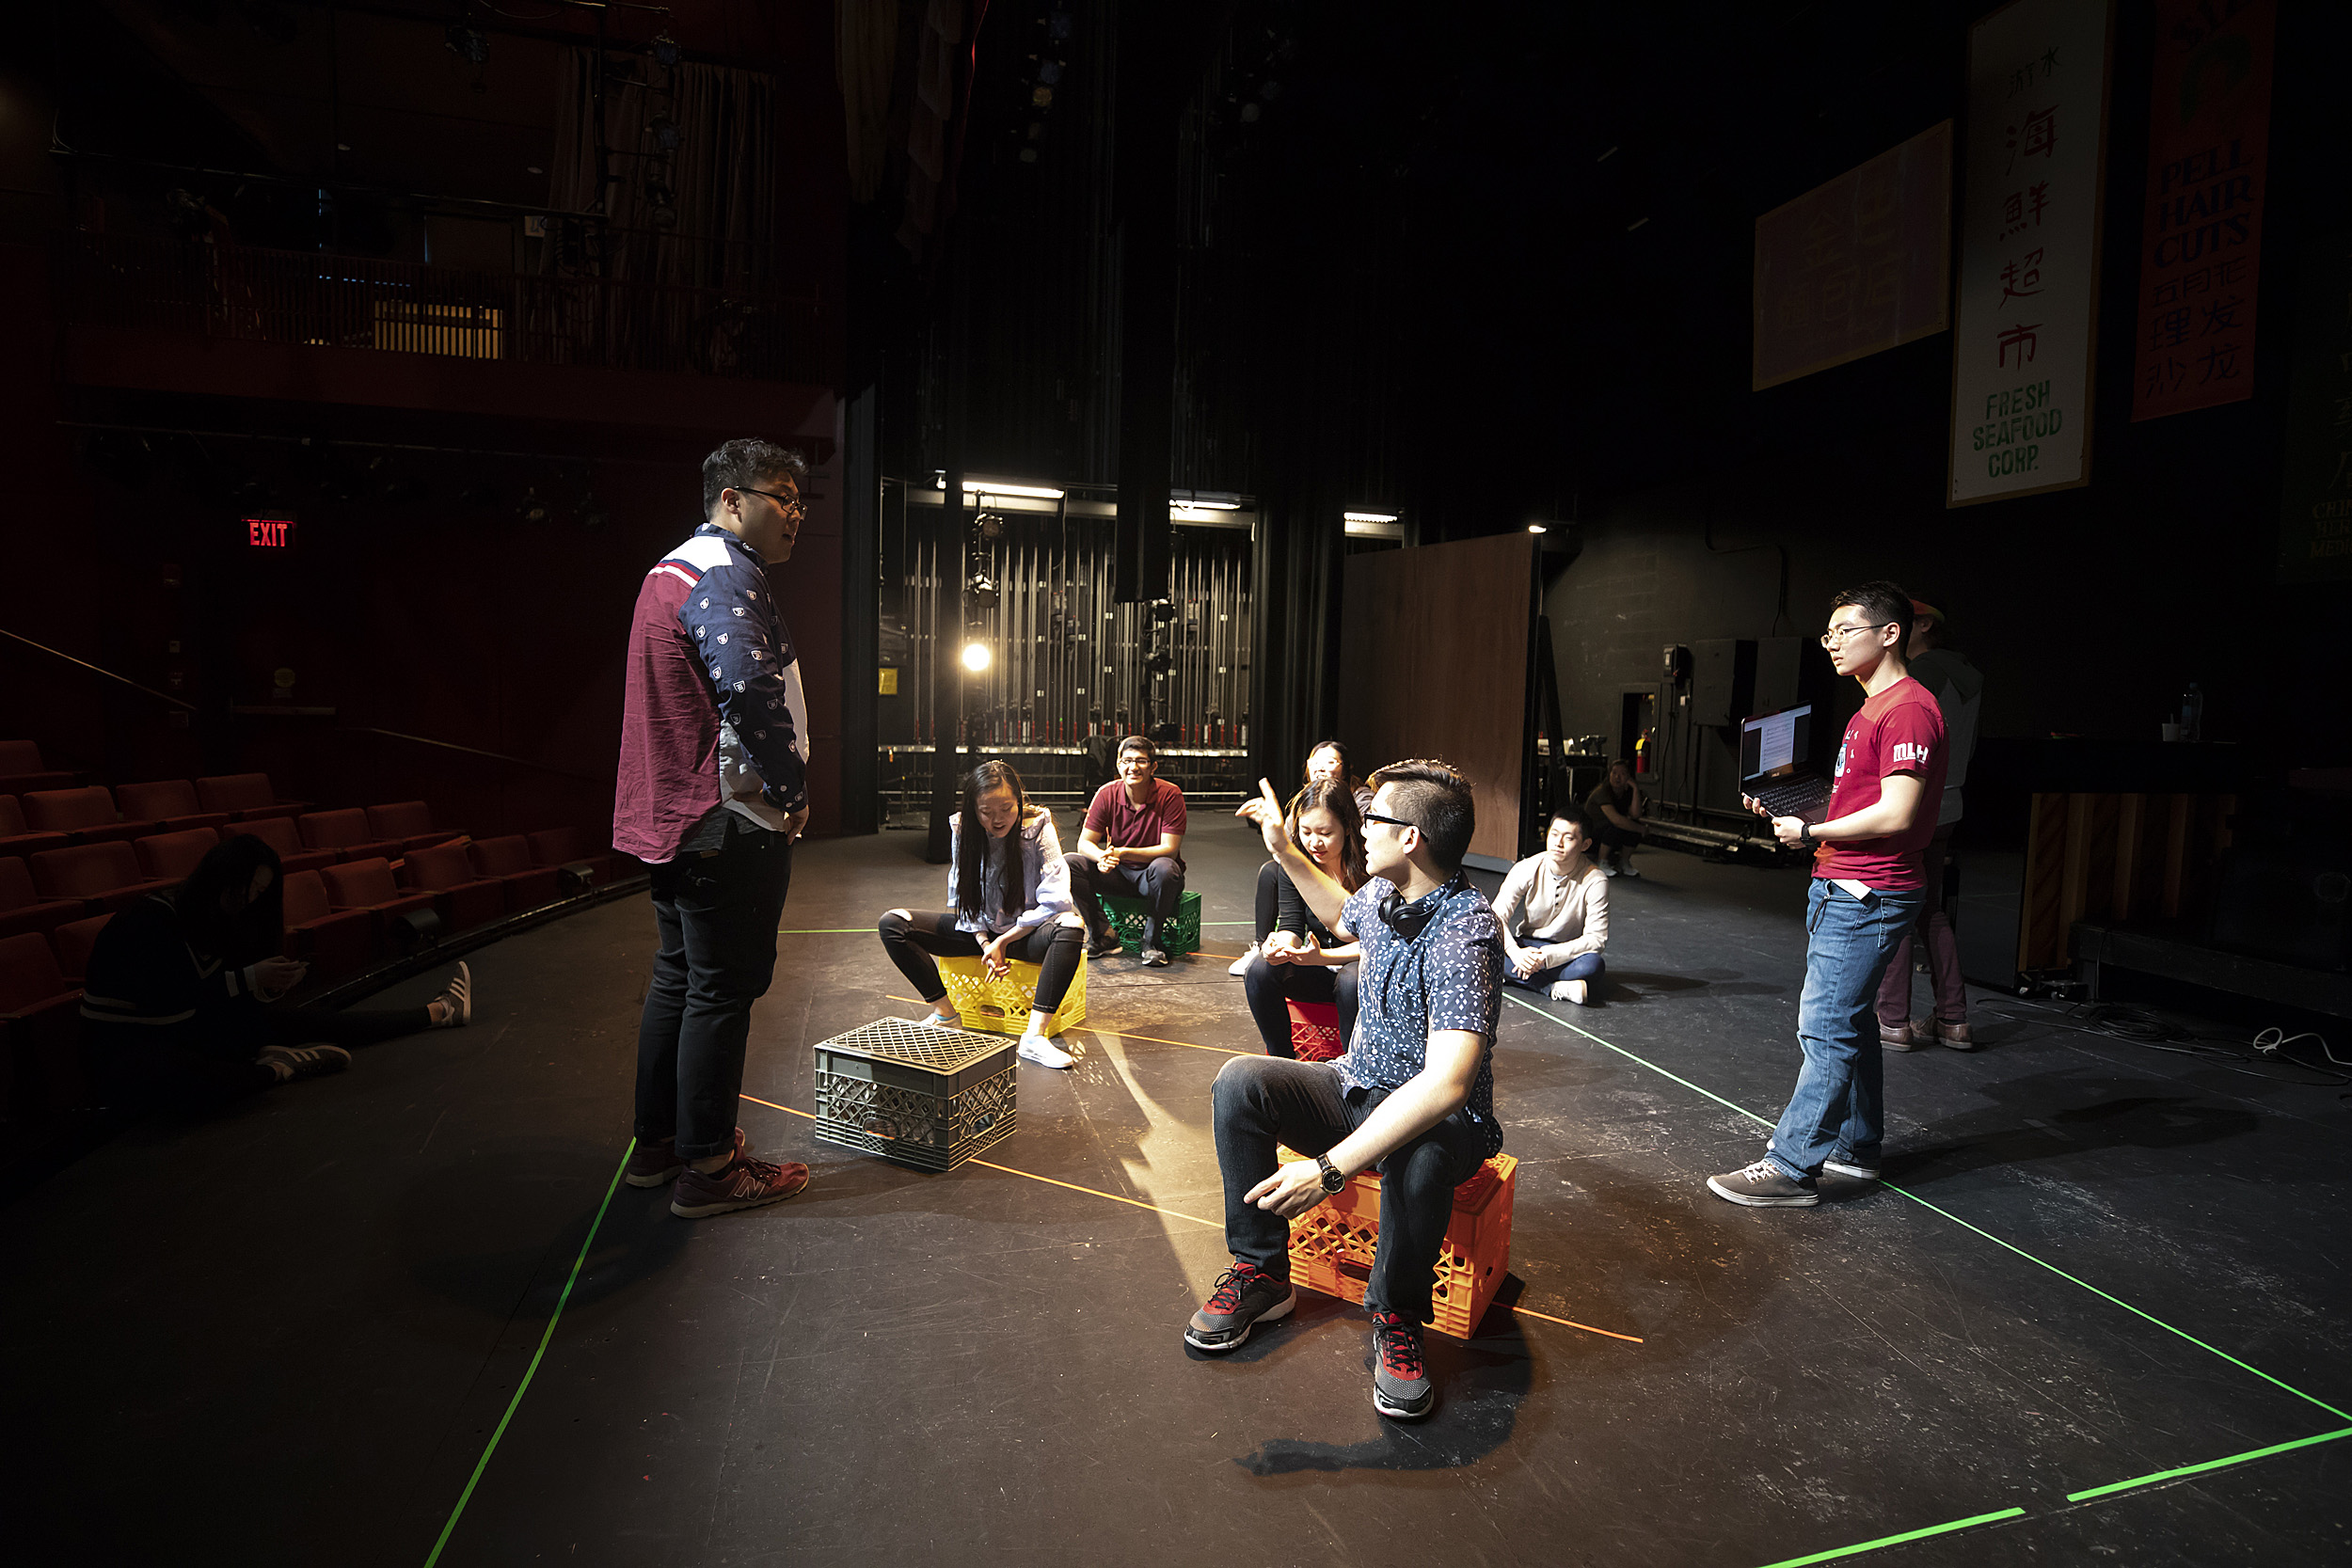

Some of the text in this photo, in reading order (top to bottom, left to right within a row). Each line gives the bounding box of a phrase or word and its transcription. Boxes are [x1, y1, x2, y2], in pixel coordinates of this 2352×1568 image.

[2161, 138, 2255, 194] PELL
[2159, 174, 2255, 232] HAIR
[1996, 104, 2060, 371] 海鮮超市
[2153, 210, 2250, 268] CUTS
[2149, 294, 2246, 352] 理发
[2145, 342, 2242, 398] 沙龙
[1986, 379, 2050, 420] FRESH
[1973, 408, 2062, 451] SEAFOOD
[1988, 444, 2040, 478] CORP.
[249, 522, 288, 546] EXIT
